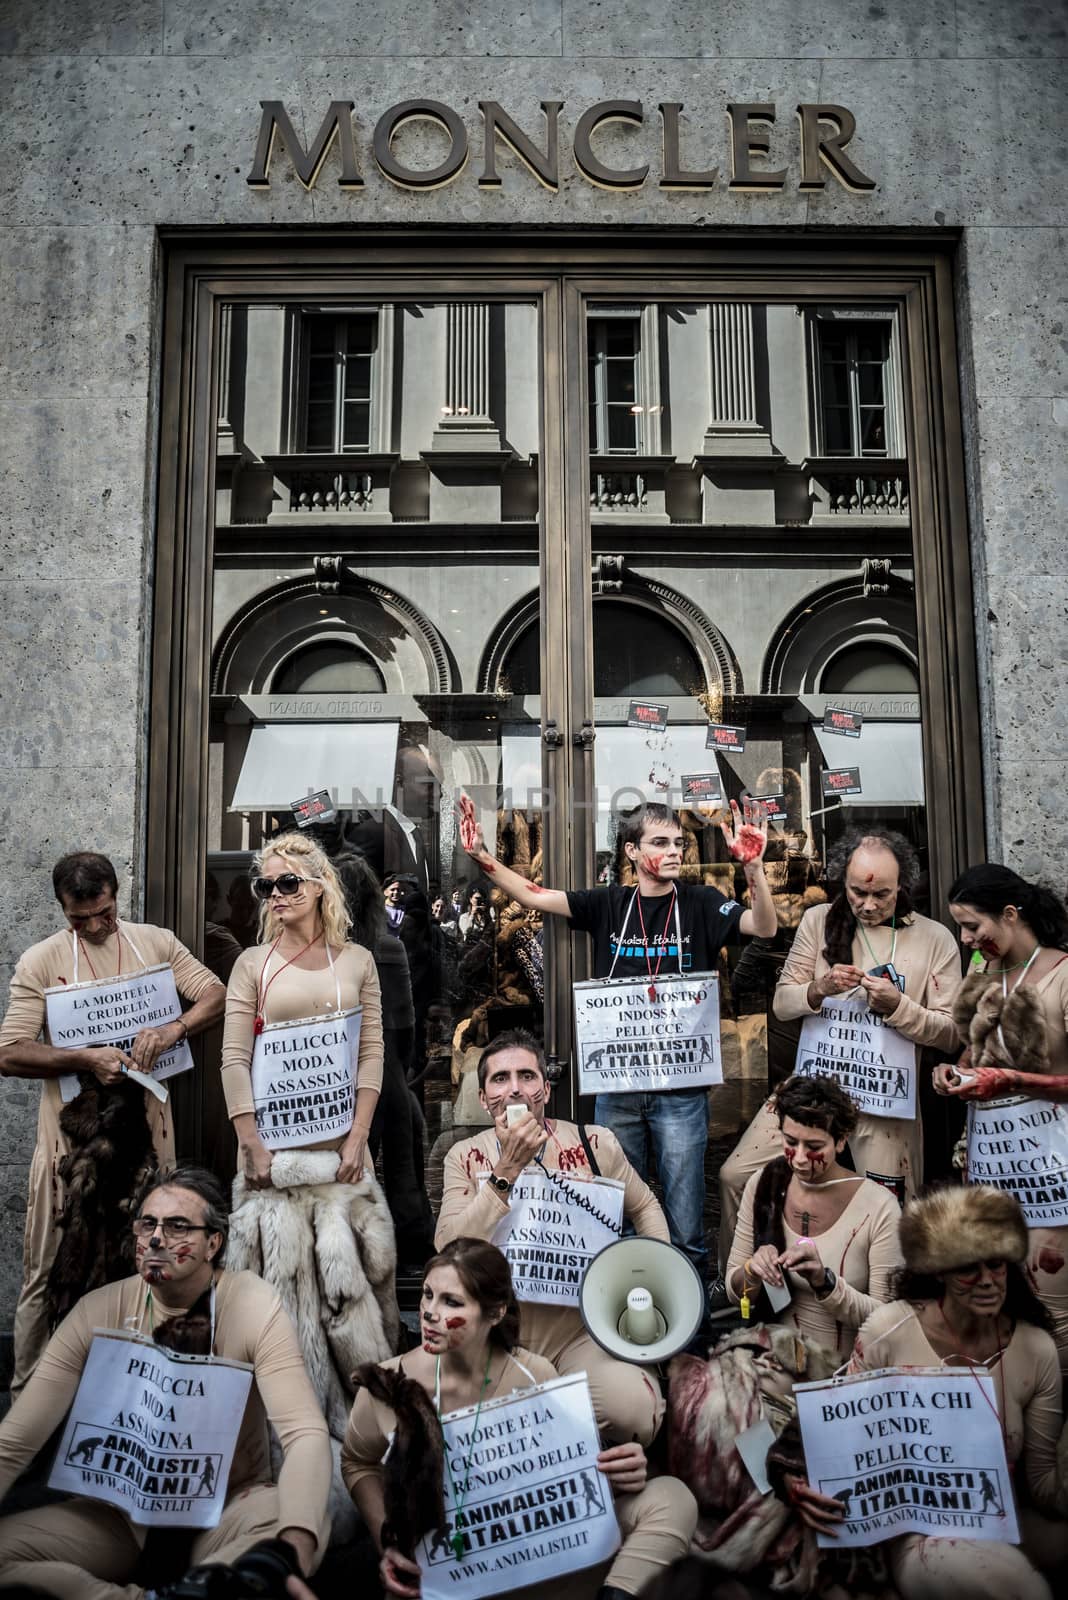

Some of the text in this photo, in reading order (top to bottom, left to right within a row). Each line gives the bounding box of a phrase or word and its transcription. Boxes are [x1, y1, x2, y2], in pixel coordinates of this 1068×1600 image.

[246, 99, 877, 193] MONCLER
[74, 1000, 90, 1009] LA
[93, 988, 137, 1006] MORTE
[144, 984, 158, 994] LA
[586, 996, 622, 1009] SOLO
[626, 994, 645, 1006] UN
[87, 998, 151, 1021] CRUDELTA'
[619, 1009, 677, 1022] INDOSSA
[58, 1005, 175, 1041] NON RENDONO BELLE
[615, 1023, 683, 1037] PELLICCE
[828, 1027, 872, 1044] CHE IN
[264, 1030, 348, 1055] PELLICCIA
[606, 1039, 697, 1054] ANIMALISTI
[817, 1041, 885, 1064] PELLICCIA
[282, 1054, 334, 1073] MODA
[609, 1052, 694, 1068] ITALIANI
[815, 1057, 892, 1080] ANIMALISTI
[267, 1069, 350, 1095] ASSASSINA
[272, 1098, 352, 1127] ITALIANI
[972, 1108, 1060, 1136] GLIO NUDI
[977, 1136, 1040, 1155] CHE IN
[972, 1154, 1062, 1175] PELLICCIA
[969, 1170, 1068, 1190] ANIMALIST
[510, 1186, 577, 1206] PELLICC
[1013, 1185, 1068, 1205] LIAN
[528, 1207, 571, 1226] MODA
[507, 1228, 587, 1249] ASSASSINA
[511, 1263, 584, 1283] TALIAN
[141, 1390, 176, 1422] MODA
[821, 1390, 972, 1422] BOICOTTA CHI
[456, 1418, 516, 1447] MORTE
[520, 1414, 531, 1429] E
[534, 1407, 554, 1425] LA
[864, 1417, 932, 1439] VENDE
[103, 1434, 200, 1474] ANIMALISTI
[854, 1443, 955, 1471] PELLICCE
[101, 1453, 190, 1495] ITALIANI
[454, 1460, 535, 1494] RENDONO
[539, 1441, 588, 1471] BELLE
[854, 1468, 975, 1496] ANIMALISTI
[455, 1478, 578, 1530] ANIMALISTI
[861, 1486, 972, 1516] ITALIANI
[460, 1501, 577, 1551] ITALIANI
[846, 1508, 985, 1536] WWW.ANIMALISTI.IT
[449, 1530, 589, 1582] WWW.ANIMALISTI.IT
